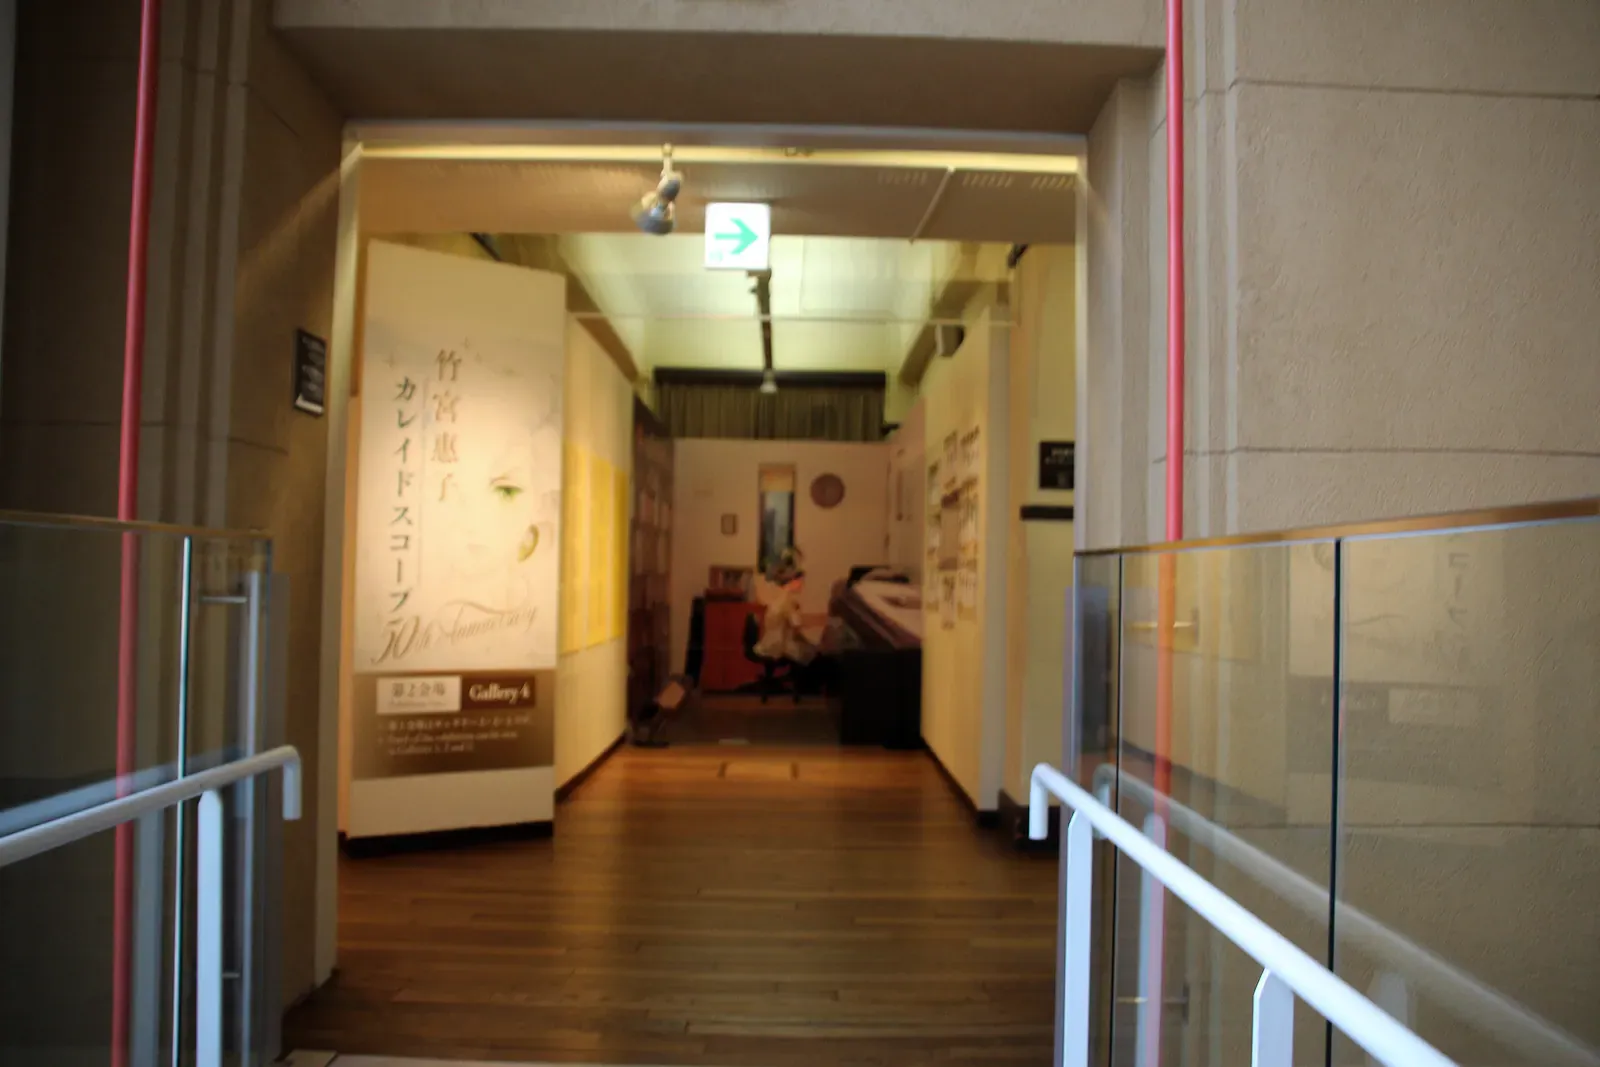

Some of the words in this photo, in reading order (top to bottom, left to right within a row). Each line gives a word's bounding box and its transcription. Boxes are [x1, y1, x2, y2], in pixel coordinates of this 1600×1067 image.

[389, 375, 416, 613] カレイドスコープ
[468, 682, 518, 704] Gallery
[518, 681, 531, 699] 4
